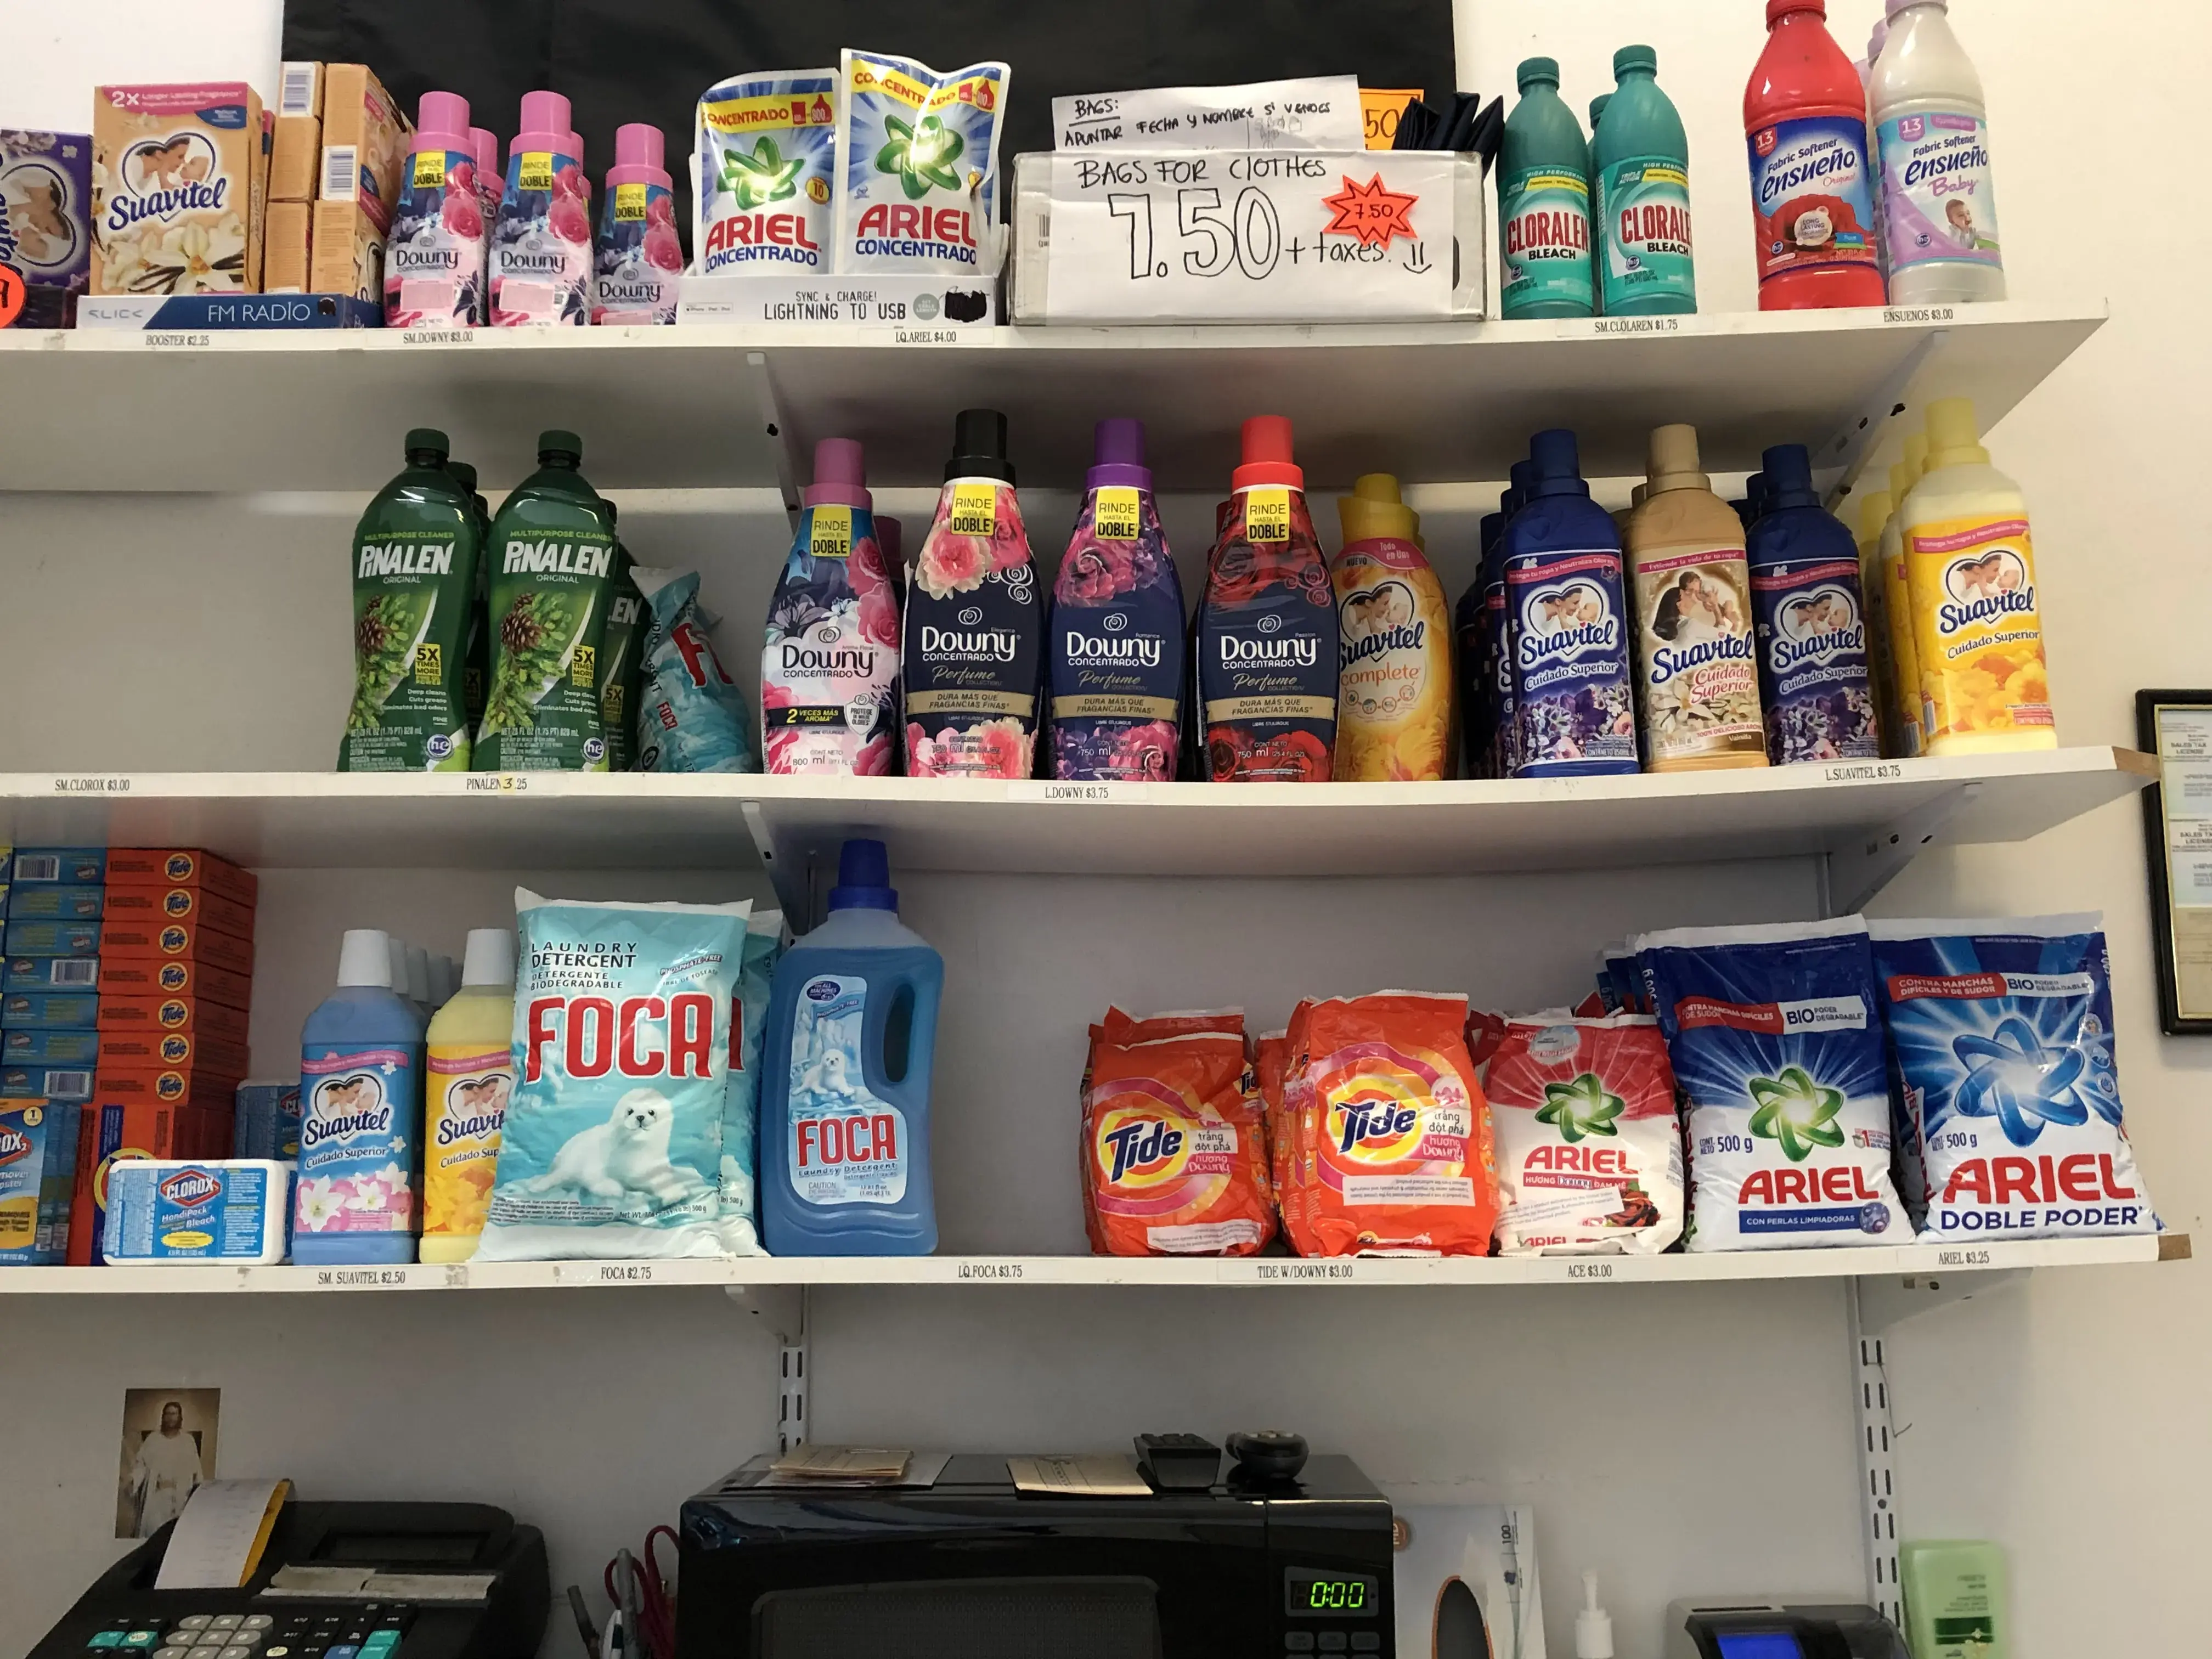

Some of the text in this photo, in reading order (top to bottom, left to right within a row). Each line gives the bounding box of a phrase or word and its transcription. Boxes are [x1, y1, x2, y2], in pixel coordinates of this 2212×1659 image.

[1065, 126, 1122, 147] APUNTAR
[1137, 117, 1180, 134] FECHA
[1901, 118, 1922, 133] 13
[1913, 134, 1976, 157] Fabric Softener
[1768, 138, 1838, 174] Fabric Softener
[1904, 145, 1988, 185] ensueño
[414, 173, 443, 185] DOBLE
[1075, 160, 1147, 189] BAGS
[1154, 159, 1210, 183] FOR
[1822, 172, 1855, 187] Original
[520, 176, 551, 188] DOBLE
[1928, 175, 1976, 197] Baby
[109, 177, 227, 230] Suavitel
[1354, 202, 1395, 219] 7.50
[616, 206, 645, 218] DOBLE
[857, 204, 977, 248] ARIEL
[705, 213, 821, 255] ARIEL
[856, 239, 977, 264] CONCENTRADO
[1528, 249, 1576, 261] BLEACH
[1647, 242, 1689, 256] BLEACH
[396, 250, 459, 269] Downy
[501, 250, 567, 274] Downy
[599, 281, 661, 302] Downy
[795, 291, 819, 302] SYNC
[837, 291, 877, 302] CHARGE!
[208, 305, 235, 322] FM
[764, 303, 906, 320] LIGHTNING TO USB
[1883, 309, 1954, 323] ENSUENOS $3.00
[1595, 320, 1678, 333] SM.CLOLAREN $1.75
[146, 335, 209, 346] BOOSTER $2.25
[403, 331, 473, 344] SM.DOWNY $3.00
[895, 331, 956, 344] LQ.ARIEL $4.00
[953, 516, 990, 533] DOBLE
[1380, 542, 1395, 551] Todo
[1346, 557, 1367, 567] NUEVO
[383, 575, 421, 584] ORIGINAL
[536, 574, 580, 584] ORIGINAL
[1940, 585, 2034, 634] Suavitel
[922, 626, 1017, 662] Downy
[1521, 620, 1613, 664] Suavitel
[1948, 629, 2039, 659] Cuidado Superior
[417, 648, 438, 662] 5X
[573, 650, 593, 664] 5X
[1651, 630, 1753, 684] Suavitel
[932, 665, 995, 689] Perfume
[1341, 662, 1419, 687] complete
[1526, 663, 1616, 690] Cuidado Superior
[1695, 664, 1750, 685] Cuidado
[961, 692, 978, 701] MÁS
[980, 693, 998, 702] QUE
[1691, 680, 1752, 704] Superior
[1108, 697, 1125, 705] MÁS
[1265, 697, 1282, 706] MÁS
[787, 709, 797, 724] 2
[1256, 747, 1268, 757] ml
[1826, 765, 1900, 780] L.SUAVITEL $3.75
[55, 779, 129, 791] SM.CLOROX $3.00
[466, 778, 501, 790] PINALEN
[1045, 786, 1109, 799] L.DOWNY $3.75
[168, 859, 191, 876] Tide
[167, 896, 189, 911] Tide
[531, 942, 639, 953] LAUNDRY
[532, 954, 637, 968] DETERGENT
[532, 971, 608, 980] DETERGENTE
[1899, 977, 1994, 988] CONTRA MANCHAS
[531, 980, 623, 990] BIODEGRADABLE
[1951, 986, 1963, 994] DE
[1965, 985, 1995, 994] SUDOR
[2008, 978, 2034, 991] BIO
[1786, 1008, 1814, 1025] BIO
[1816, 1013, 1861, 1022] DEGRADABLE
[525, 991, 714, 1085] FOCA
[796, 1113, 898, 1169] FOCA
[1718, 1135, 1753, 1153] 500 g
[1946, 1133, 1978, 1148] 500 g
[306, 1147, 386, 1169] Cuidado Superior
[441, 1150, 479, 1168] Cuidado
[1524, 1145, 1639, 1175] ARIEL
[799, 1162, 896, 1178] Laundry Detergent
[1943, 1153, 2136, 1204] ARIEL
[166, 1176, 214, 1201] CLOROX
[186, 1215, 215, 1229] Bleach
[1746, 1214, 1855, 1226] CON PERLAS LIMPIADORAS
[1941, 1208, 2137, 1231] DOBLE PODER
[1938, 1251, 1990, 1265] ARIEL $3.25
[336, 1272, 379, 1284] SUAVITEL
[381, 1271, 405, 1283] $2.50
[601, 1266, 652, 1279] FOCA $2.75
[958, 1265, 1022, 1278] LQ.FOCA $3.75
[1257, 1265, 1353, 1279] TIDE W/DOWNY $3.00
[1568, 1264, 1612, 1277] ACE $3.00
[1310, 1582, 1364, 1608] 0:00
